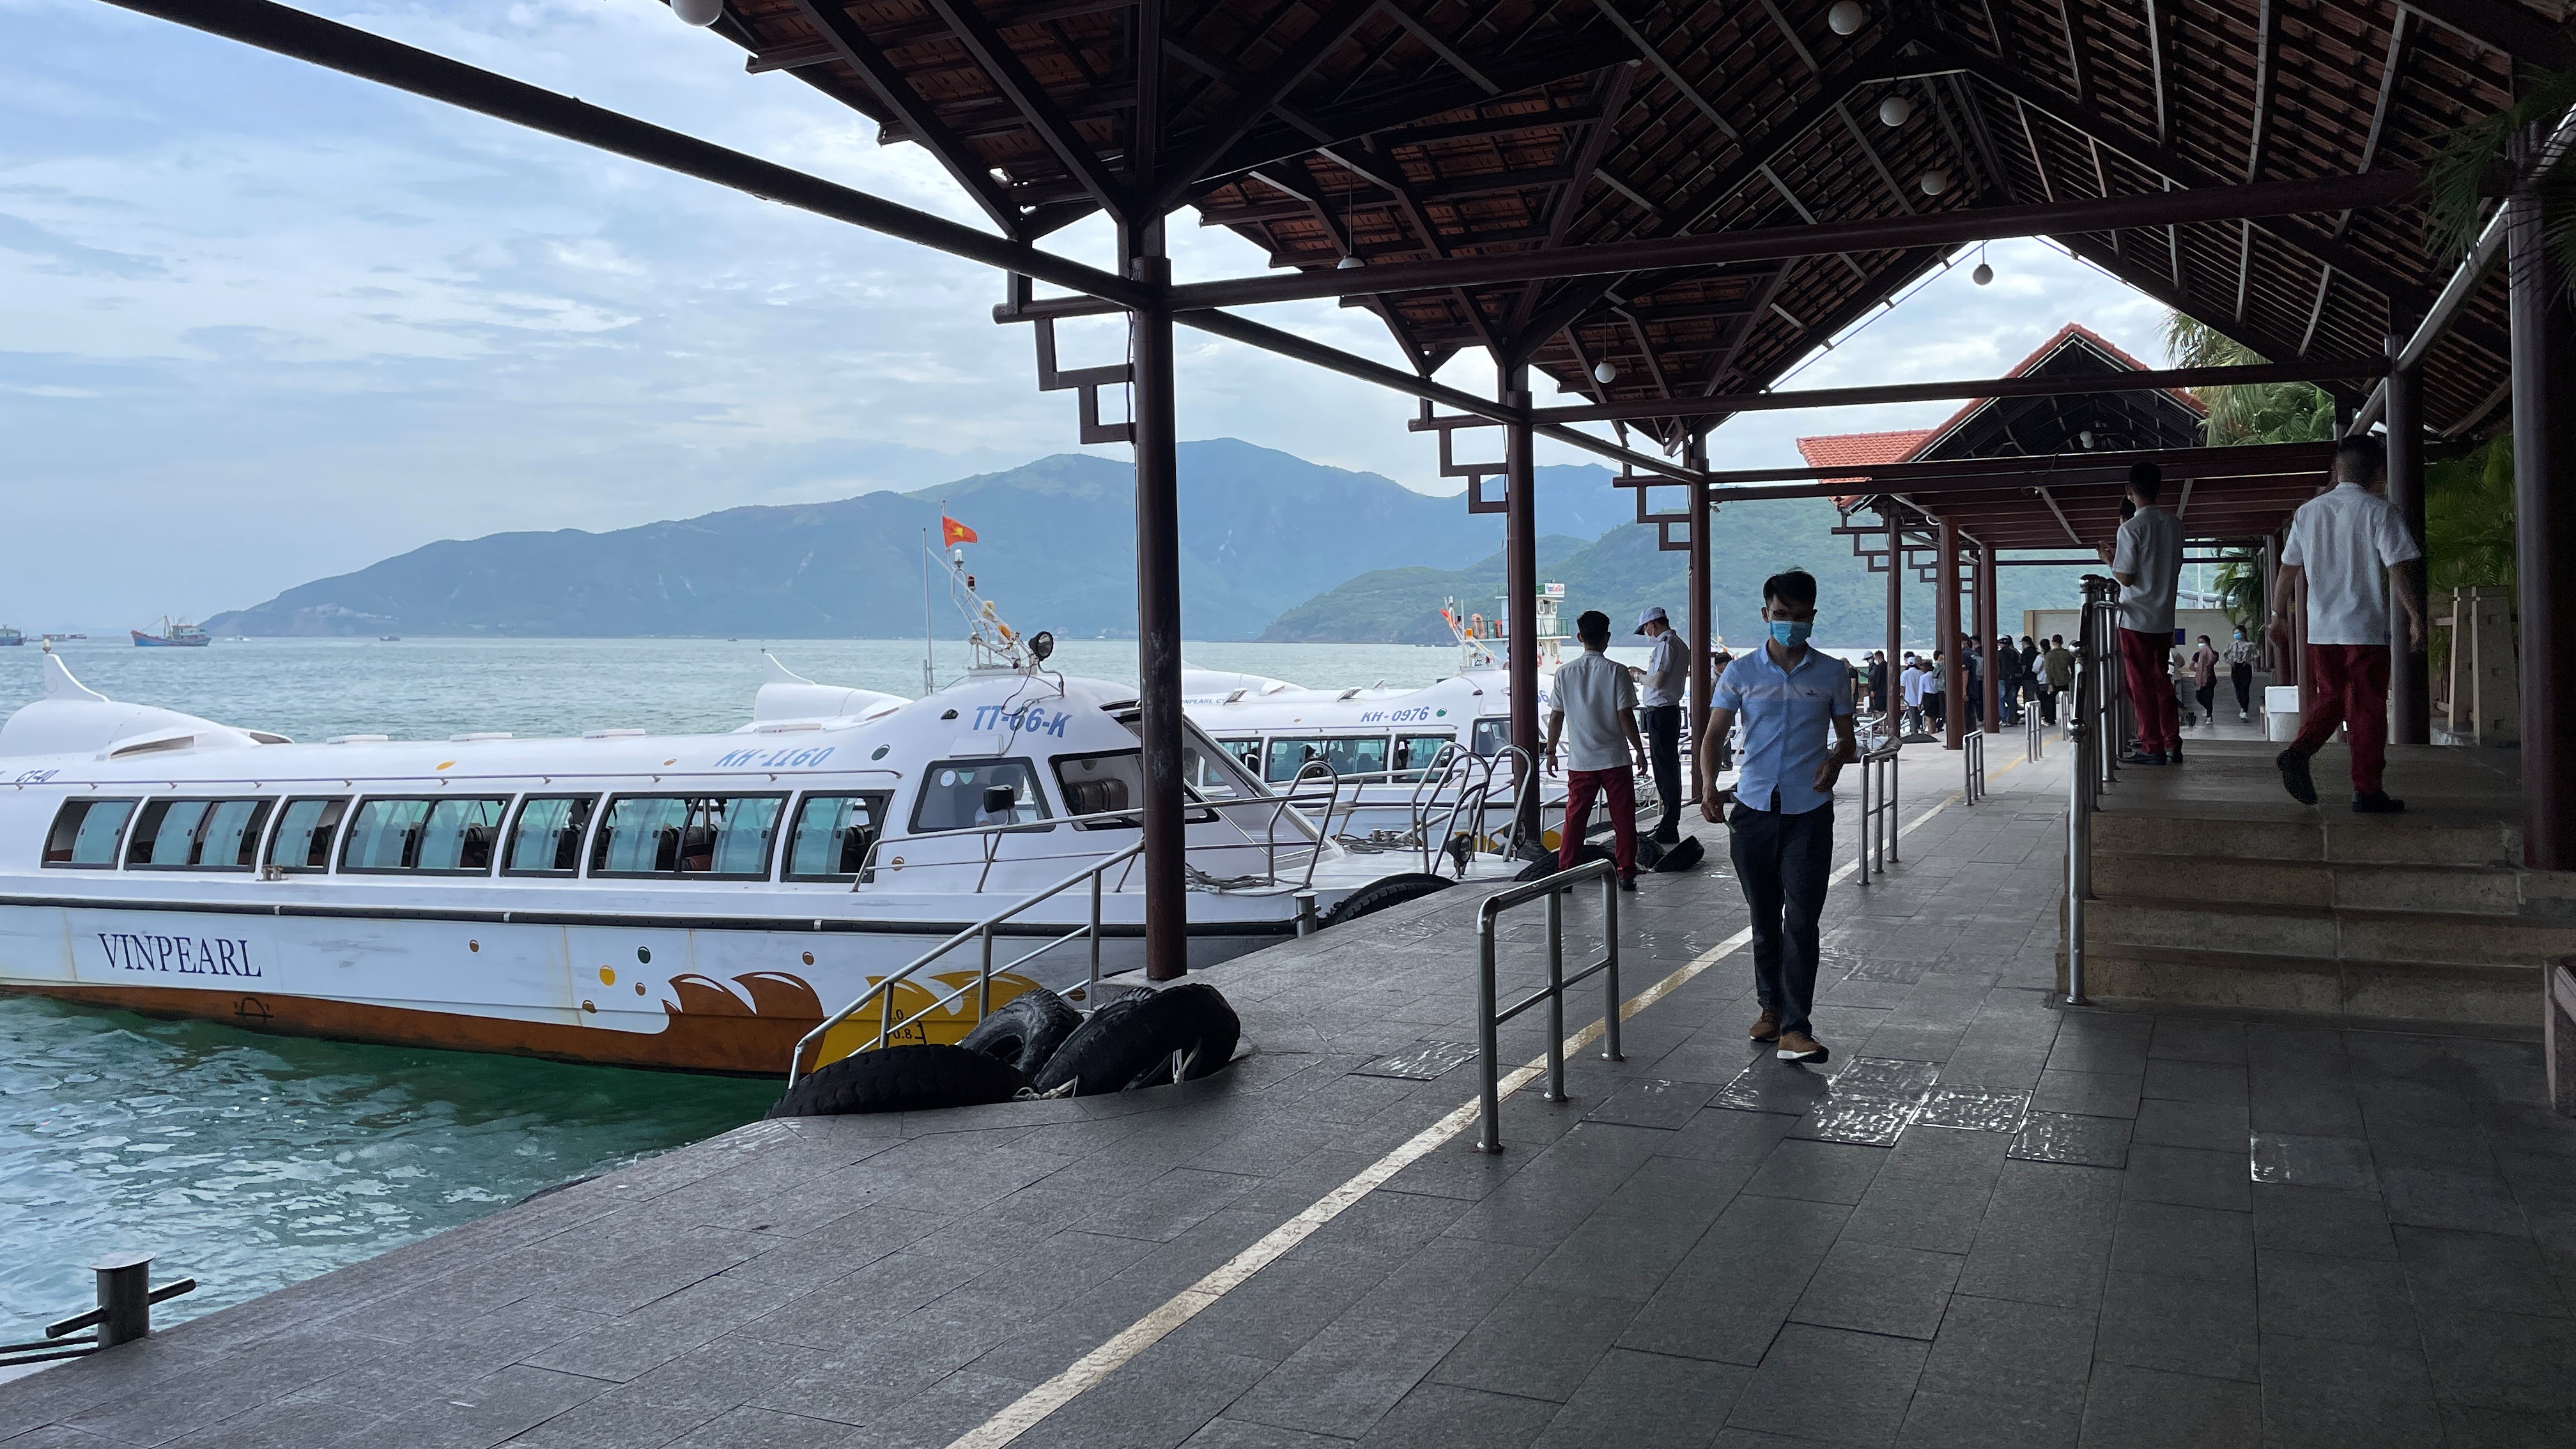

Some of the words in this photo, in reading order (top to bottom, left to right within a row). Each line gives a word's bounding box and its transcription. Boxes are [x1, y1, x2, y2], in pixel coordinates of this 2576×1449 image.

[973, 705, 1073, 738] TT-66-K
[1361, 706, 1429, 723] KH-0976
[714, 746, 835, 767] KH-1160
[97, 933, 262, 977] VINPEARL
[890, 1009, 904, 1020] .0
